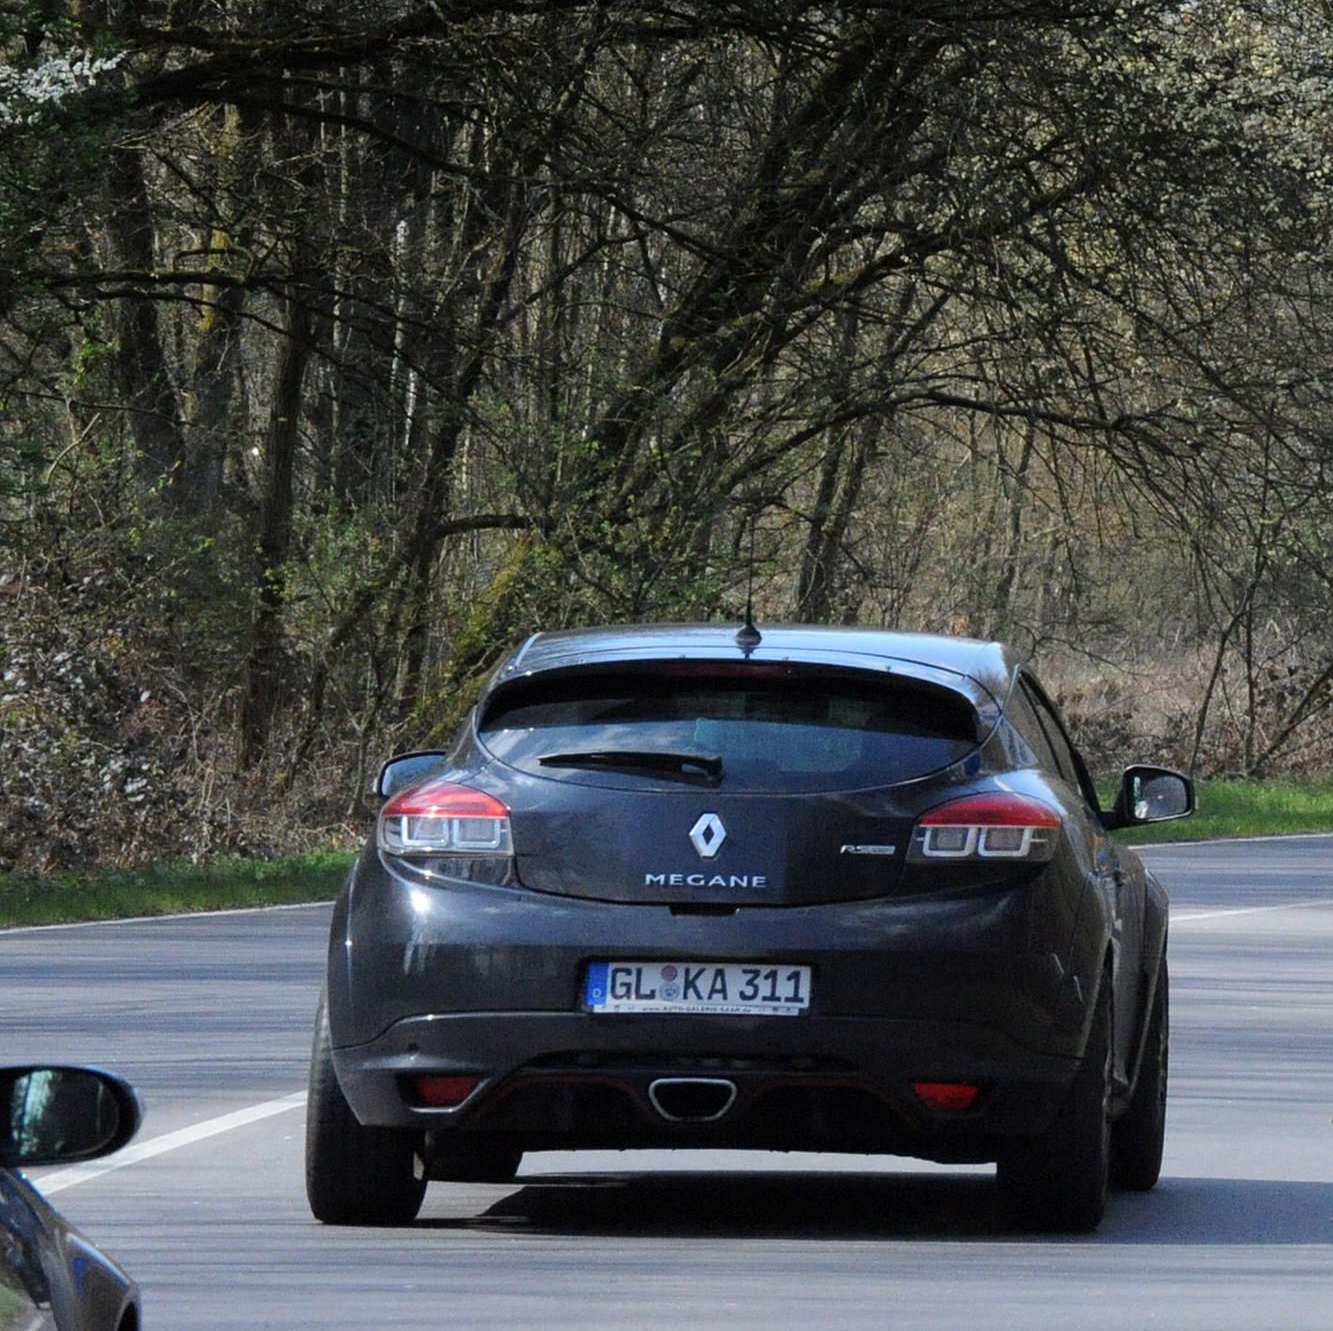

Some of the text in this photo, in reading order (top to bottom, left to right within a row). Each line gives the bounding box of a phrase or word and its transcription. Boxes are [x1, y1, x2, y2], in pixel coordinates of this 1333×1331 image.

[645, 873, 767, 888] MEGANE
[610, 967, 656, 1000] GL
[683, 968, 728, 1001] KA
[739, 969, 804, 1003] 311
